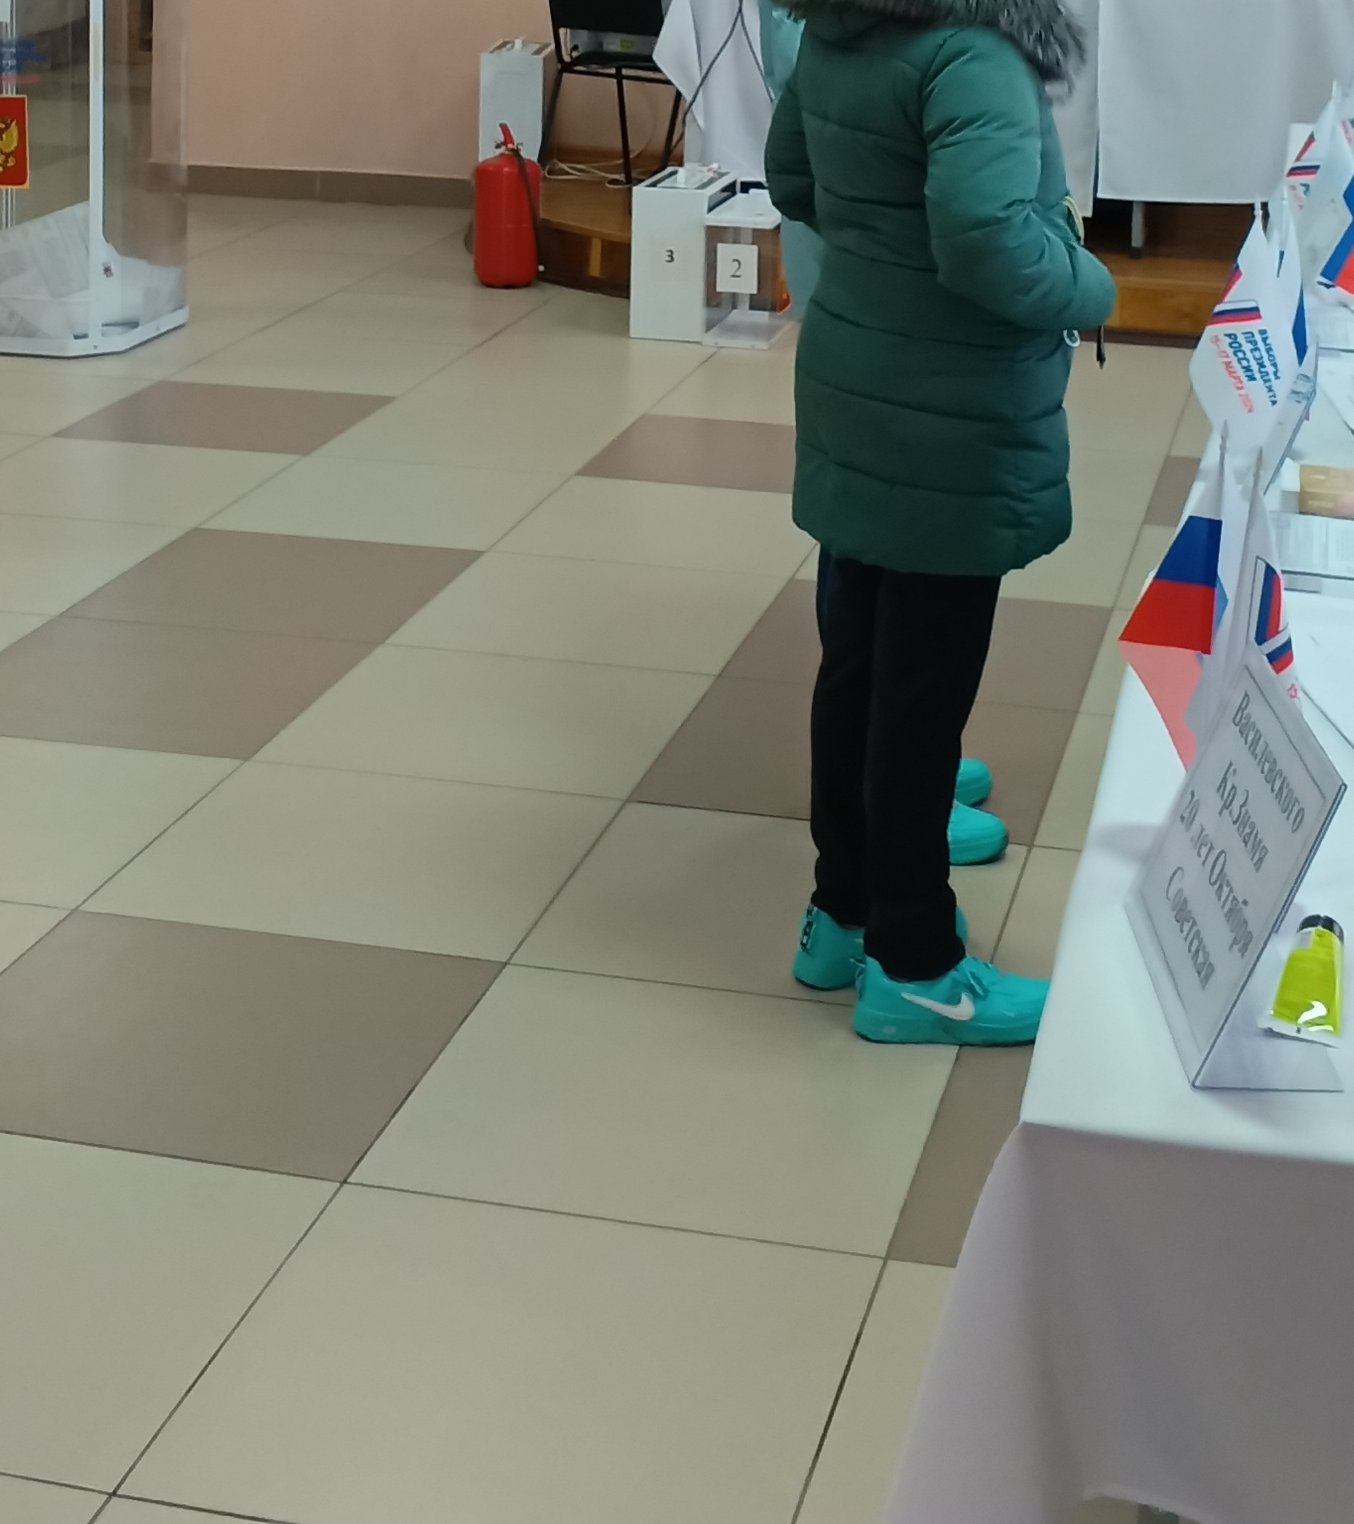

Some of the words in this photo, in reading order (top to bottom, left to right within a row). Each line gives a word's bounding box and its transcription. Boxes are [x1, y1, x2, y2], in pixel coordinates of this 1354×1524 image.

[664, 249, 675, 264] 3
[729, 258, 742, 278] 2
[1224, 333, 1257, 382] РОССИИ
[1241, 331, 1278, 407] ПРЕЗИДЕНТА
[1258, 329, 1281, 381] ВЫБОРЫ
[1233, 691, 1305, 833] Василевского
[1180, 789, 1201, 828] 20
[1190, 824, 1216, 867] лет
[1166, 866, 1215, 990] Советская
[1208, 849, 1254, 960] Октября
